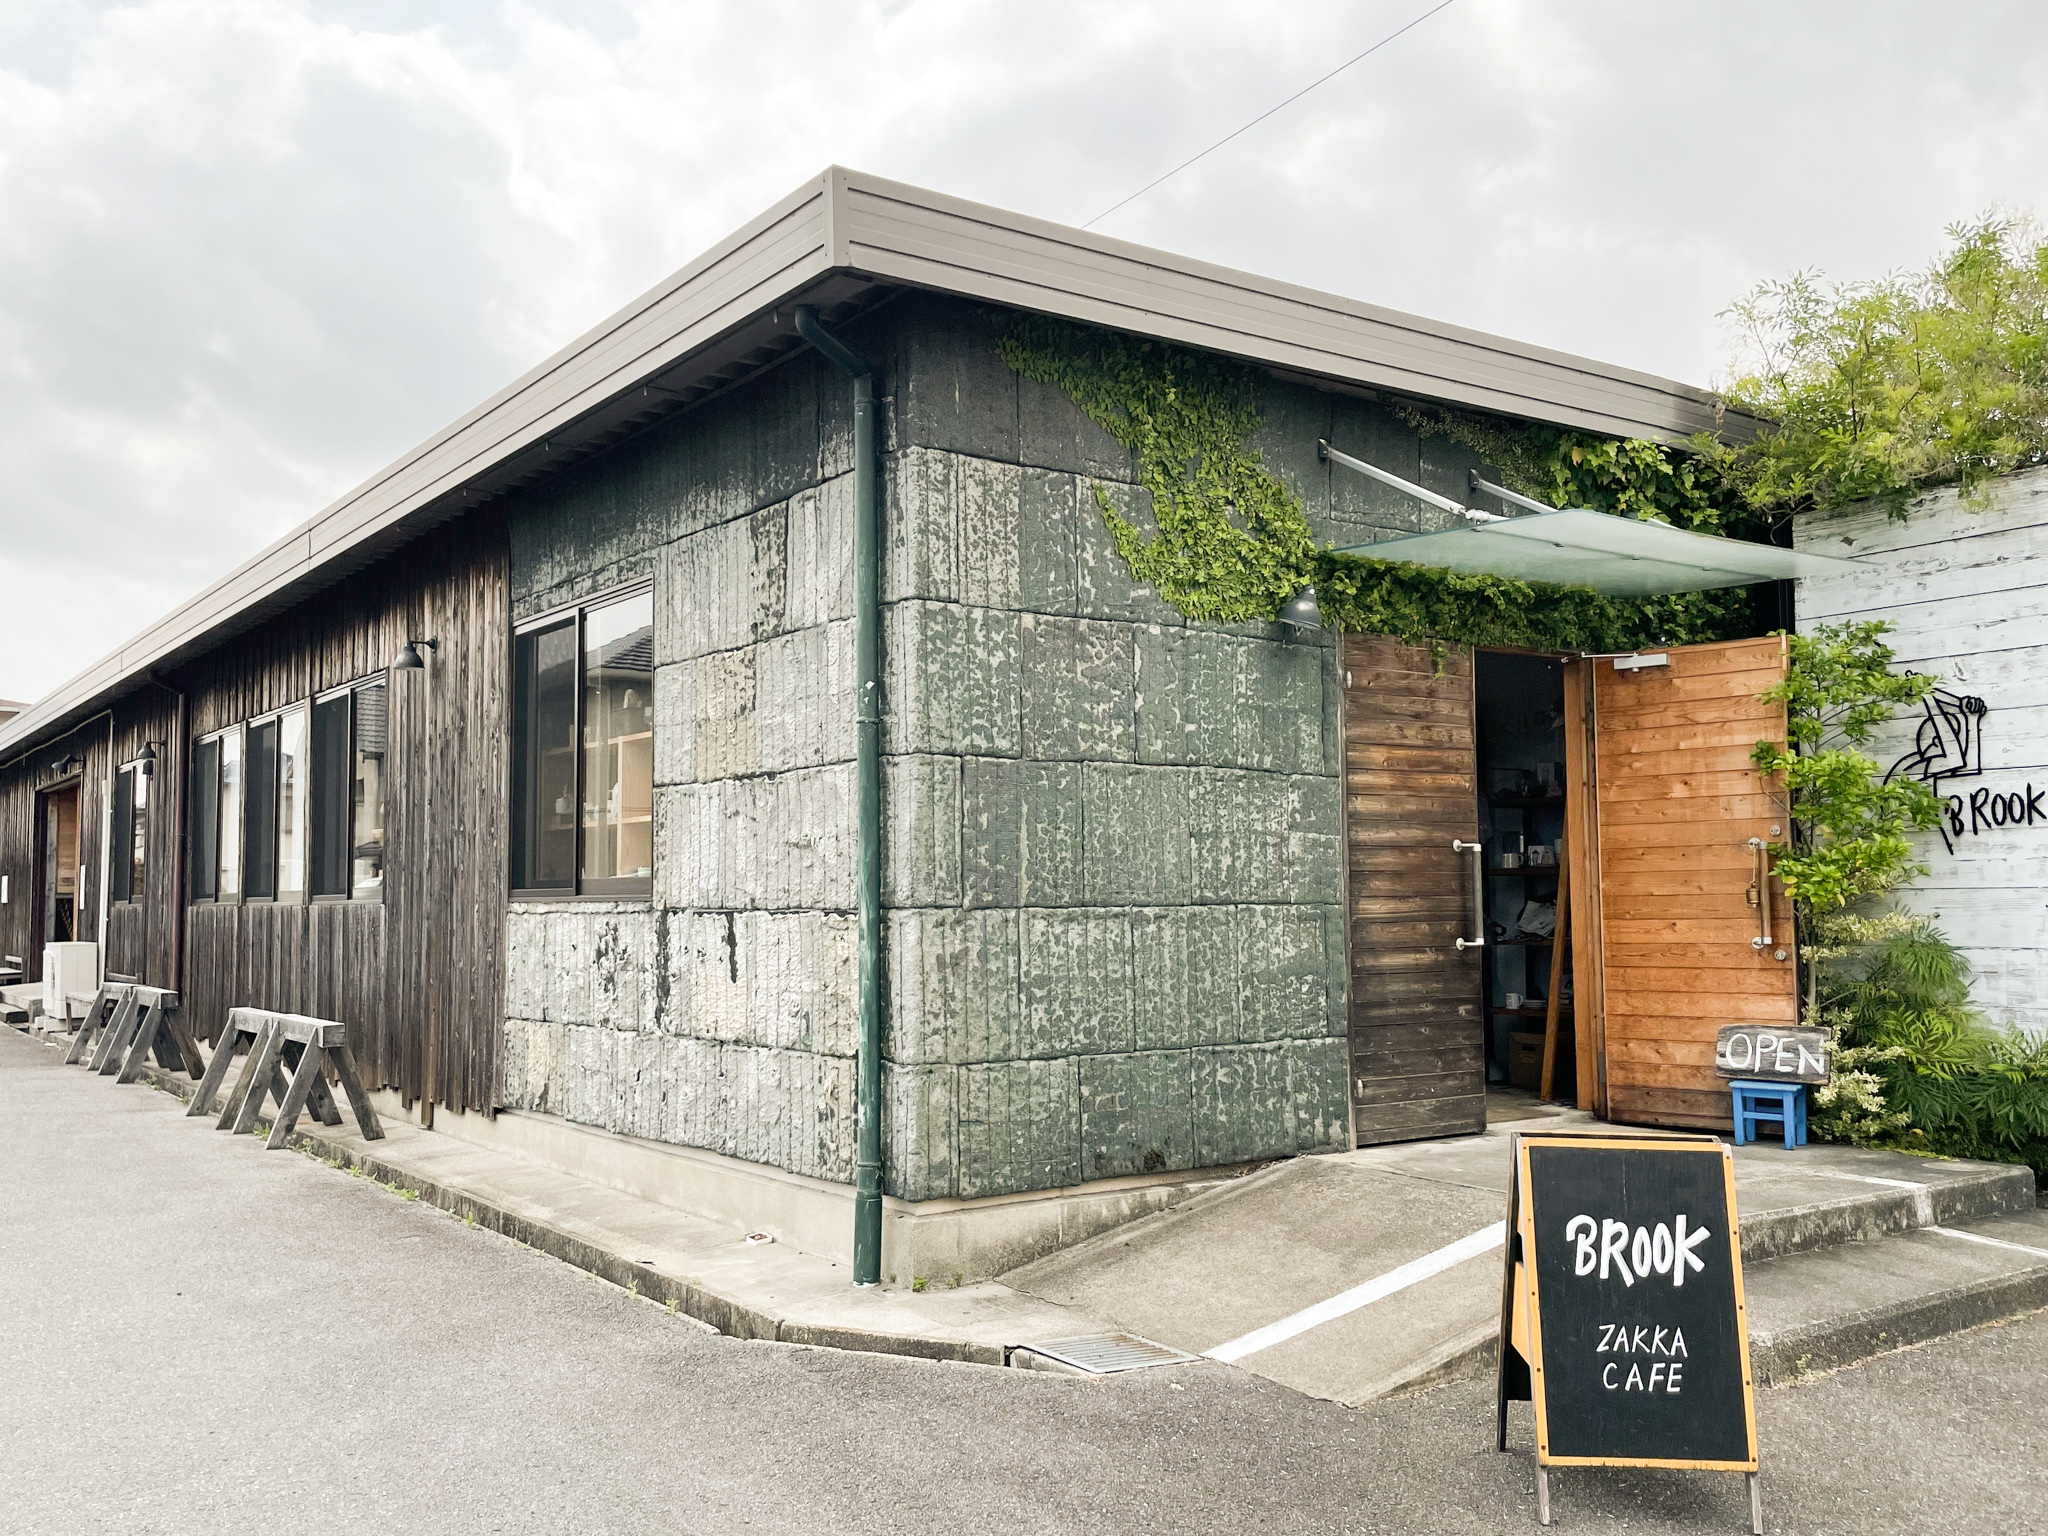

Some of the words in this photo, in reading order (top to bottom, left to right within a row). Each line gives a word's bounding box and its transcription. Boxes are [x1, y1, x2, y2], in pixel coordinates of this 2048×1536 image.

[1943, 782, 2048, 837] BROOK
[1725, 1033, 1826, 1075] OPEN
[1565, 1213, 1712, 1288] BROOK
[1595, 1323, 1688, 1358] ZAKKA
[1602, 1362, 1683, 1393] CAFE
